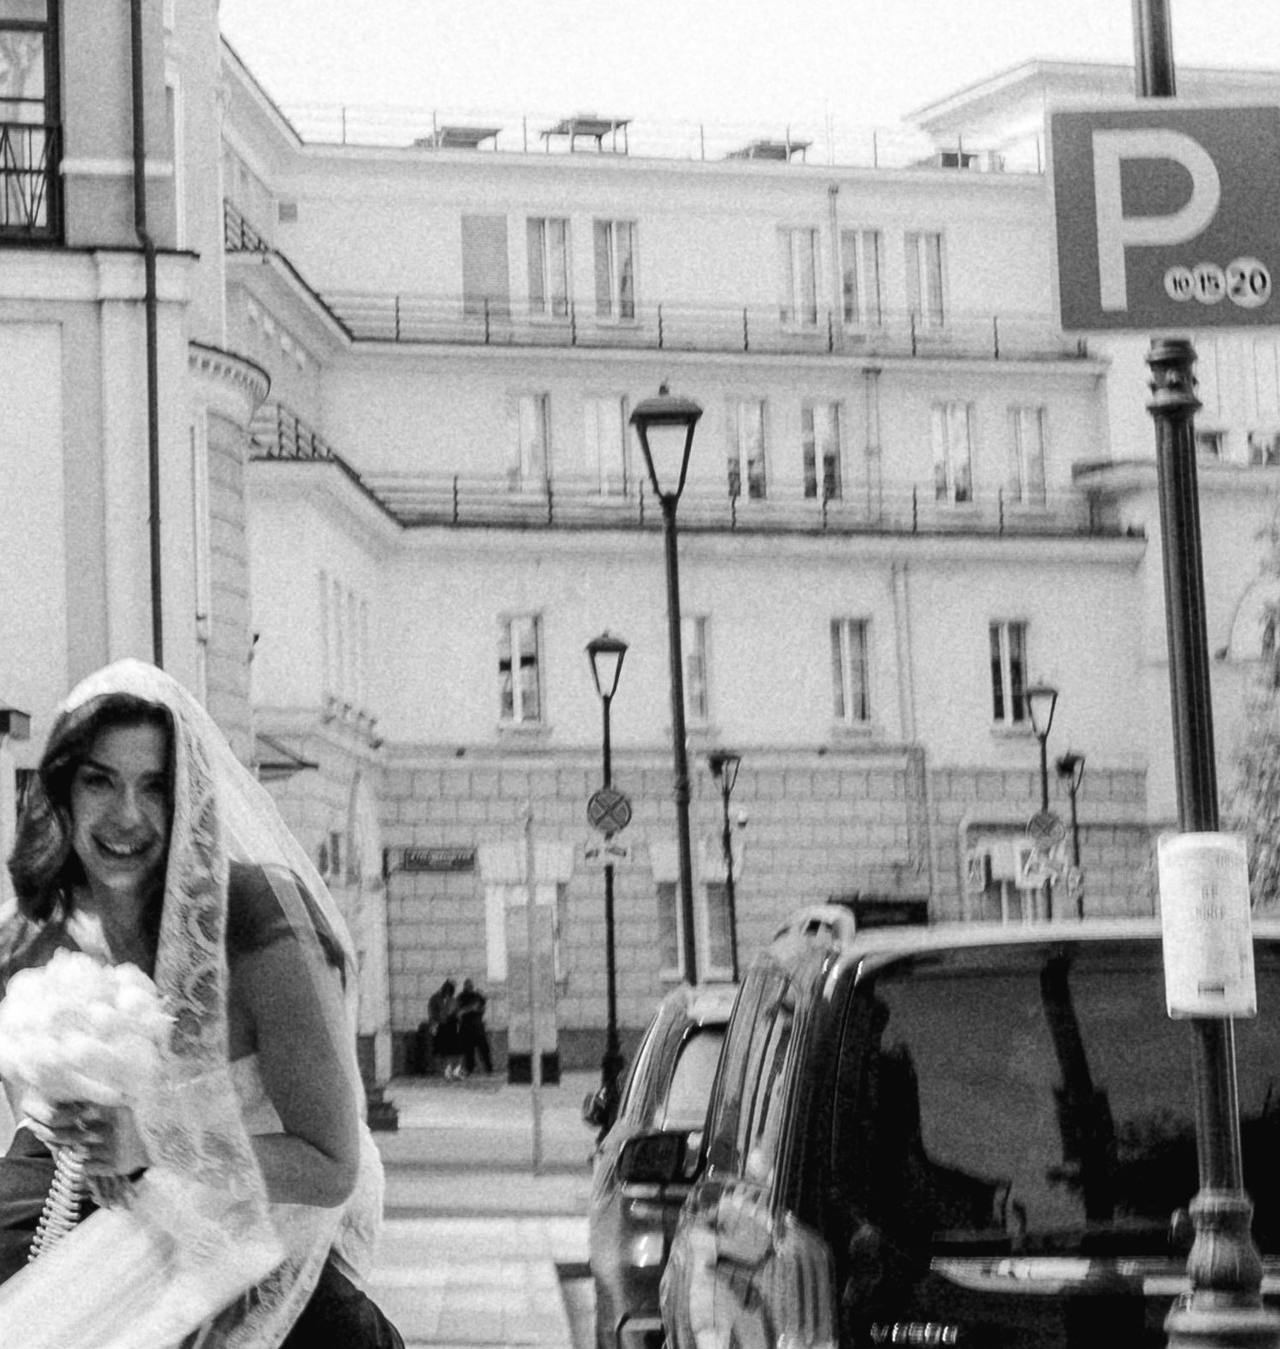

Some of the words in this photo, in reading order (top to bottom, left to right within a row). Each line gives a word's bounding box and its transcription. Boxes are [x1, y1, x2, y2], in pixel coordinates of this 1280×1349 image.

[1091, 127, 1221, 312] P
[1171, 274, 1191, 296] 10
[1229, 266, 1269, 298] 20
